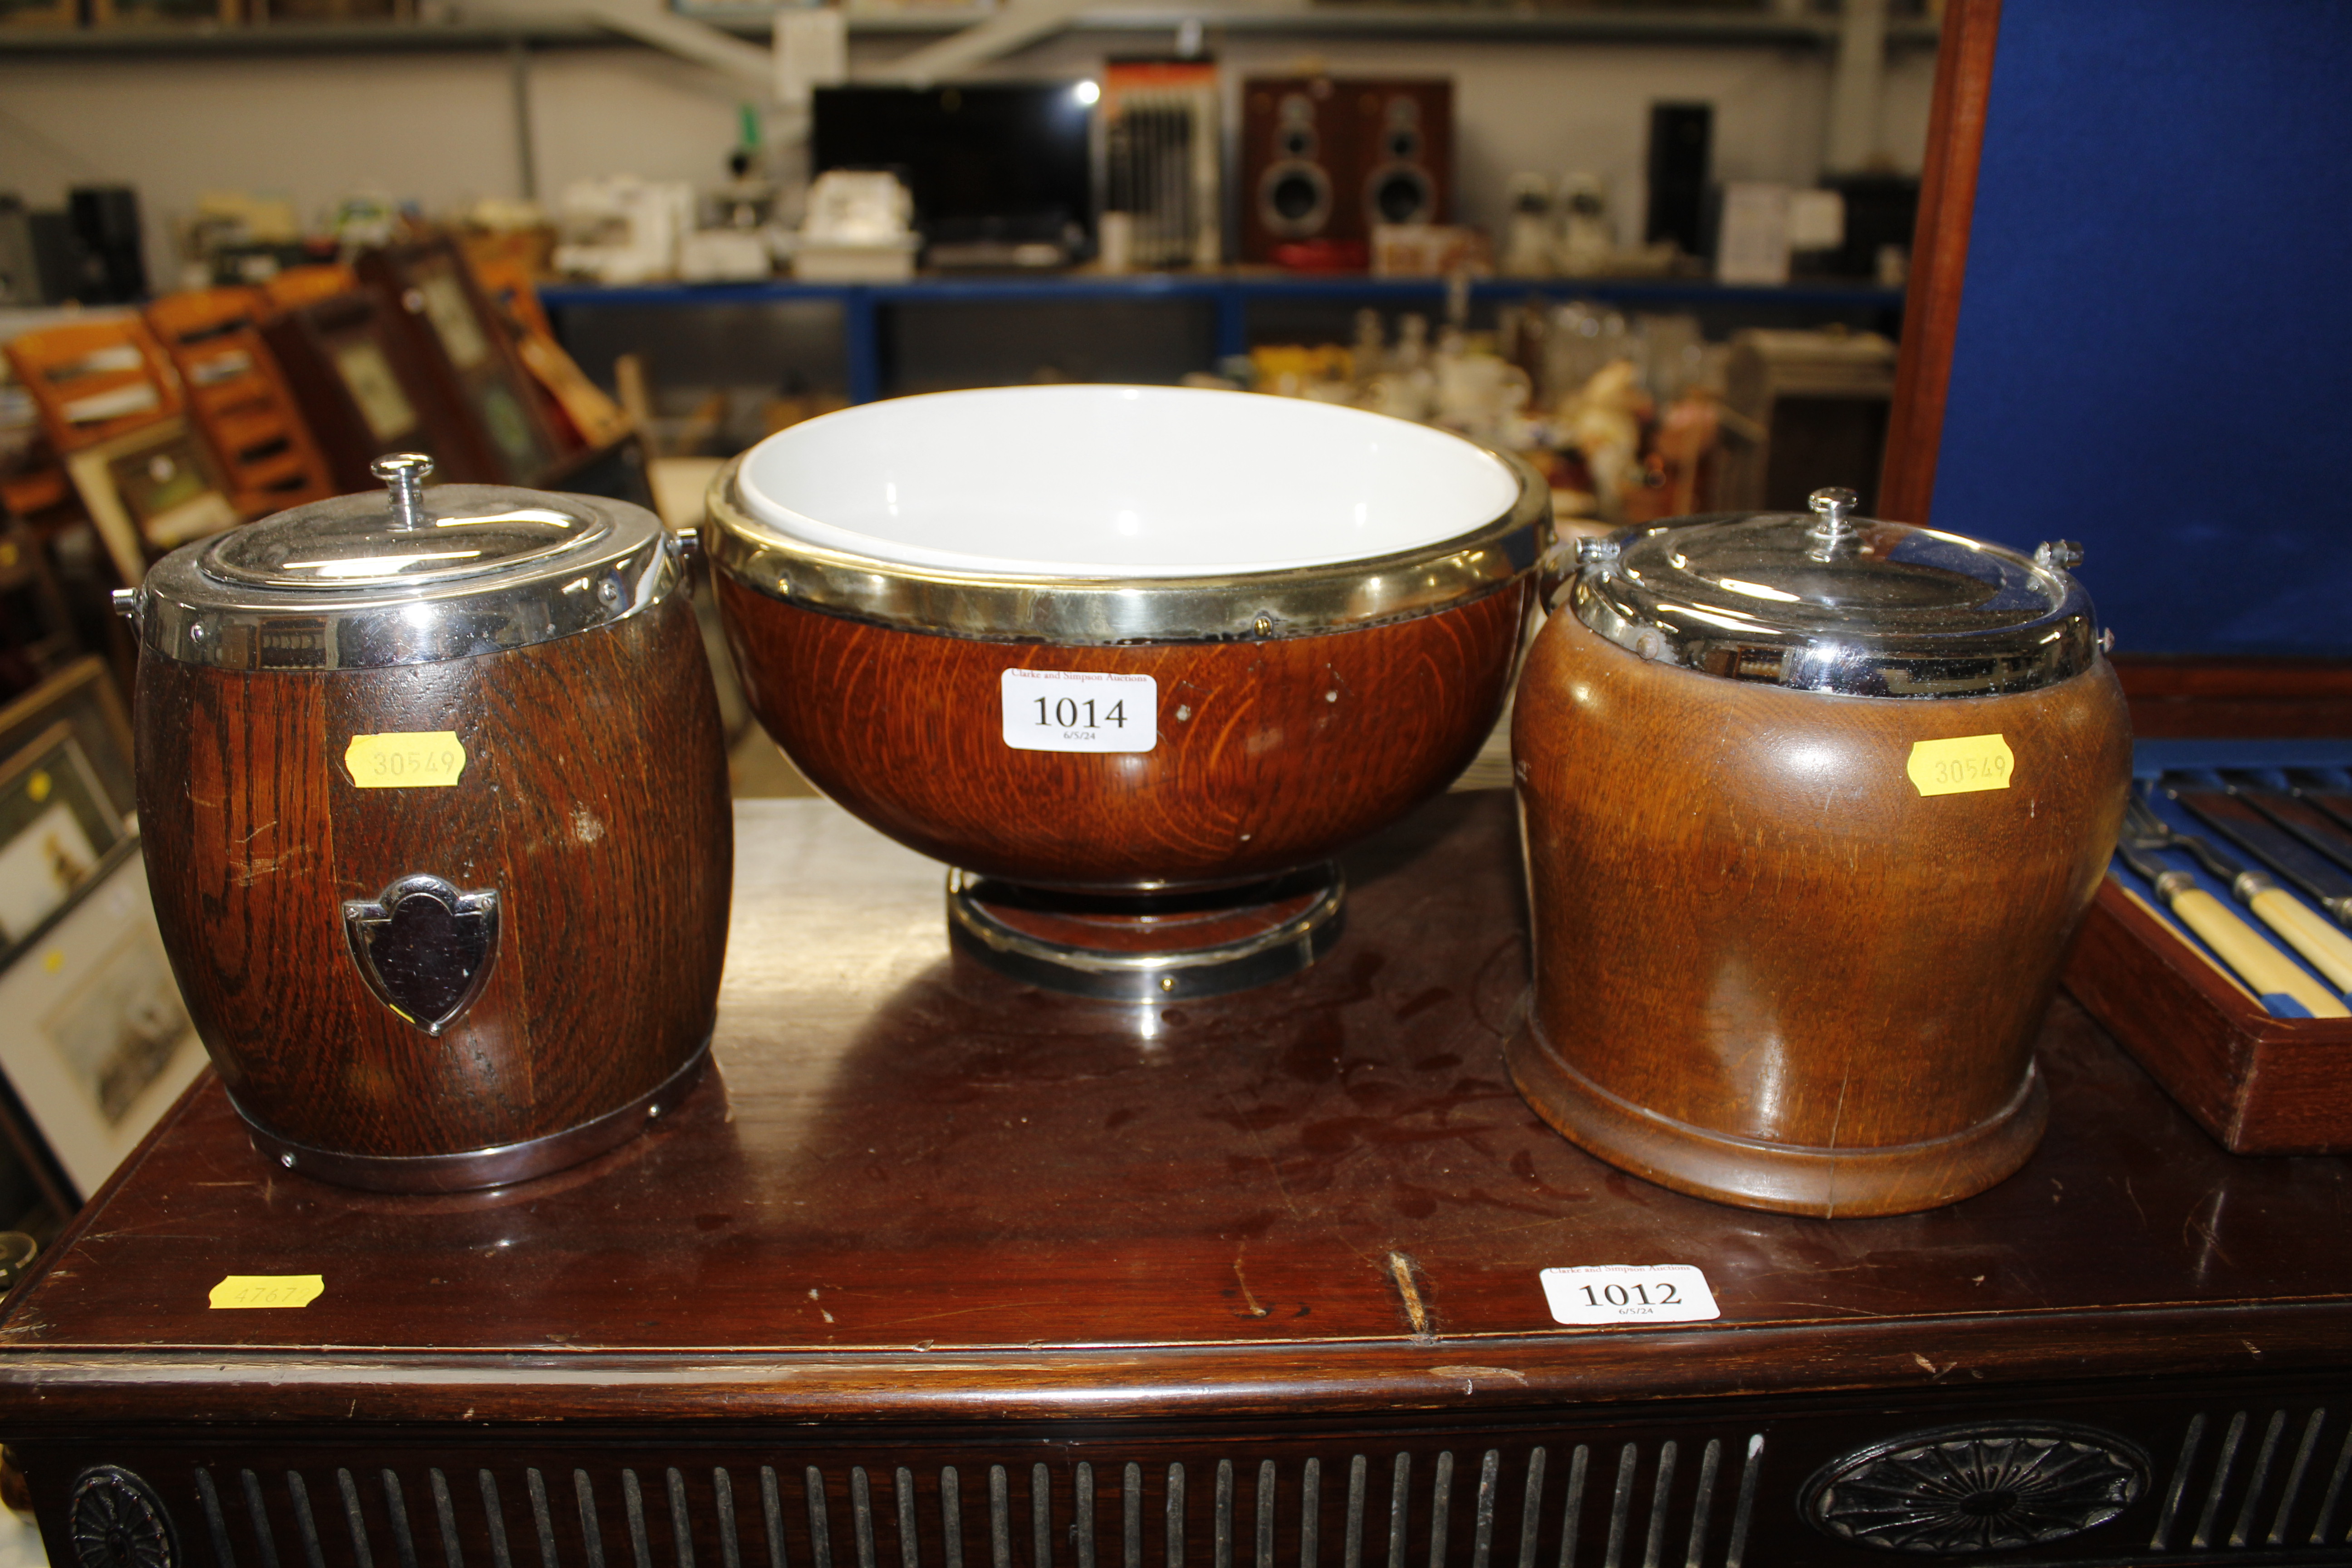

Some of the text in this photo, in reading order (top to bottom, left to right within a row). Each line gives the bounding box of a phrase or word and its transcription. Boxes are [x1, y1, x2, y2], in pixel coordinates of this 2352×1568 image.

[1011, 669, 1147, 682] Clarke and Simpson Auctions
[1034, 696, 1128, 728] 1014
[1063, 731, 1096, 740] 6/5/24
[373, 750, 455, 776] 30549
[1935, 755, 2006, 784] 30549
[234, 1288, 310, 1303] 47672
[1579, 1283, 1682, 1306] 1012
